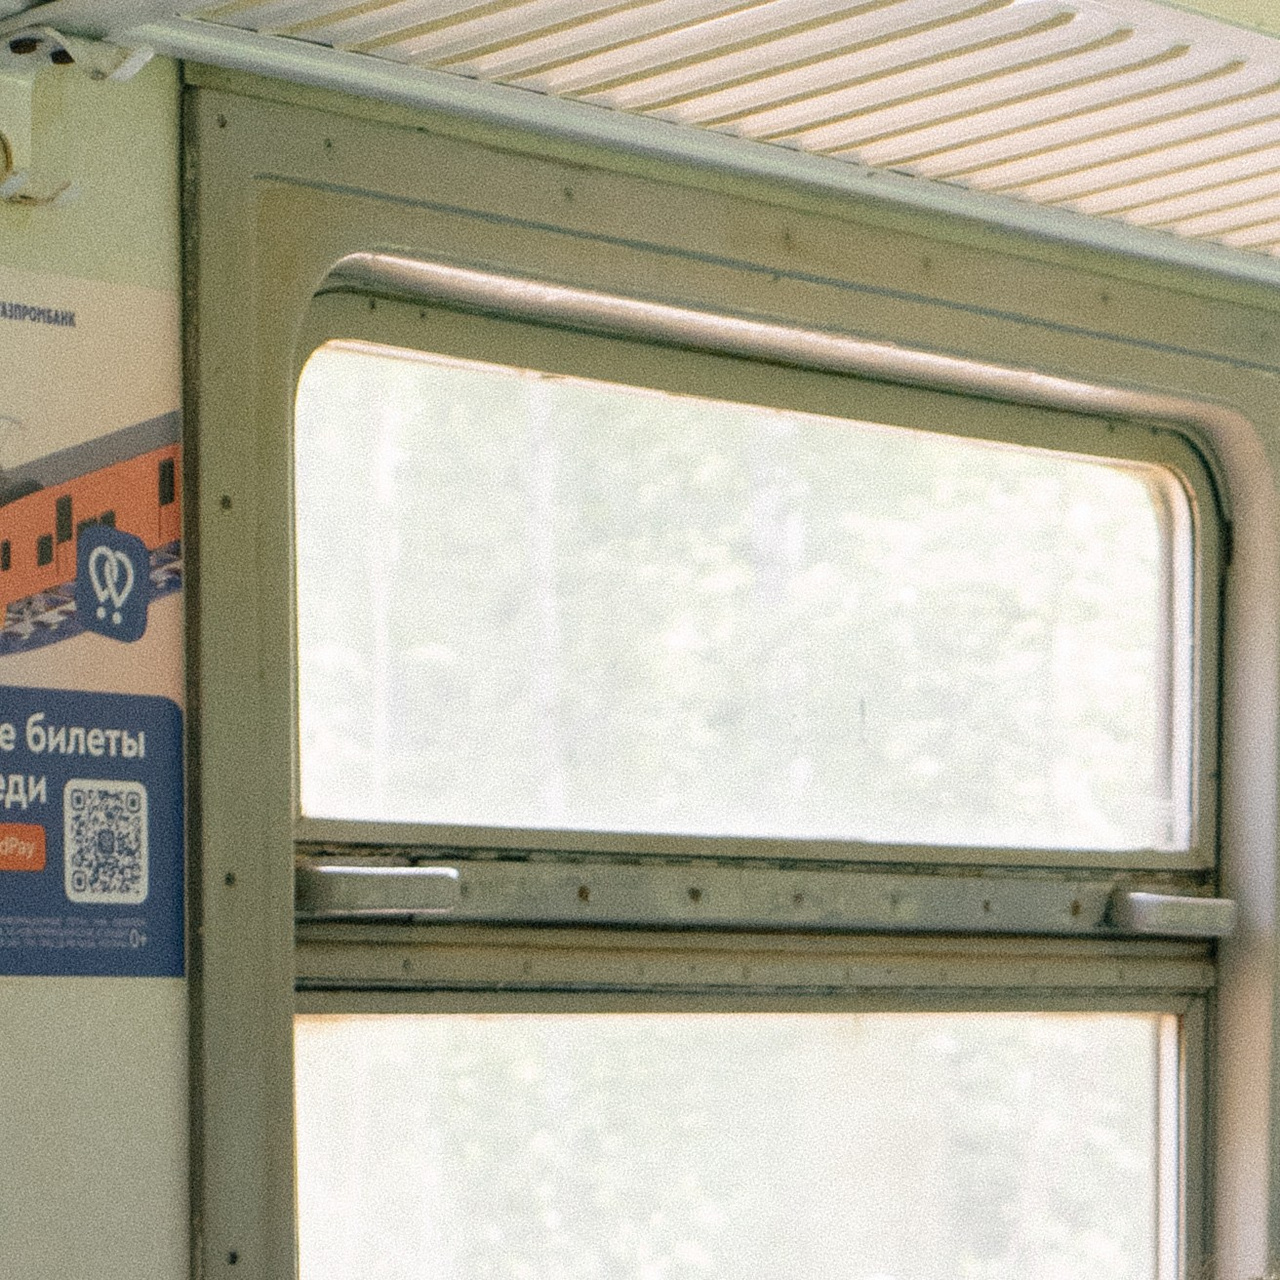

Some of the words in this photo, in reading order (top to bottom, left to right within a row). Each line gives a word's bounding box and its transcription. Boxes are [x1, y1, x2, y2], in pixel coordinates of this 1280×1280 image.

[0, 301, 76, 328] АЗПРОМБАНК
[26, 712, 146, 759] билеты
[129, 928, 148, 948] 0+
